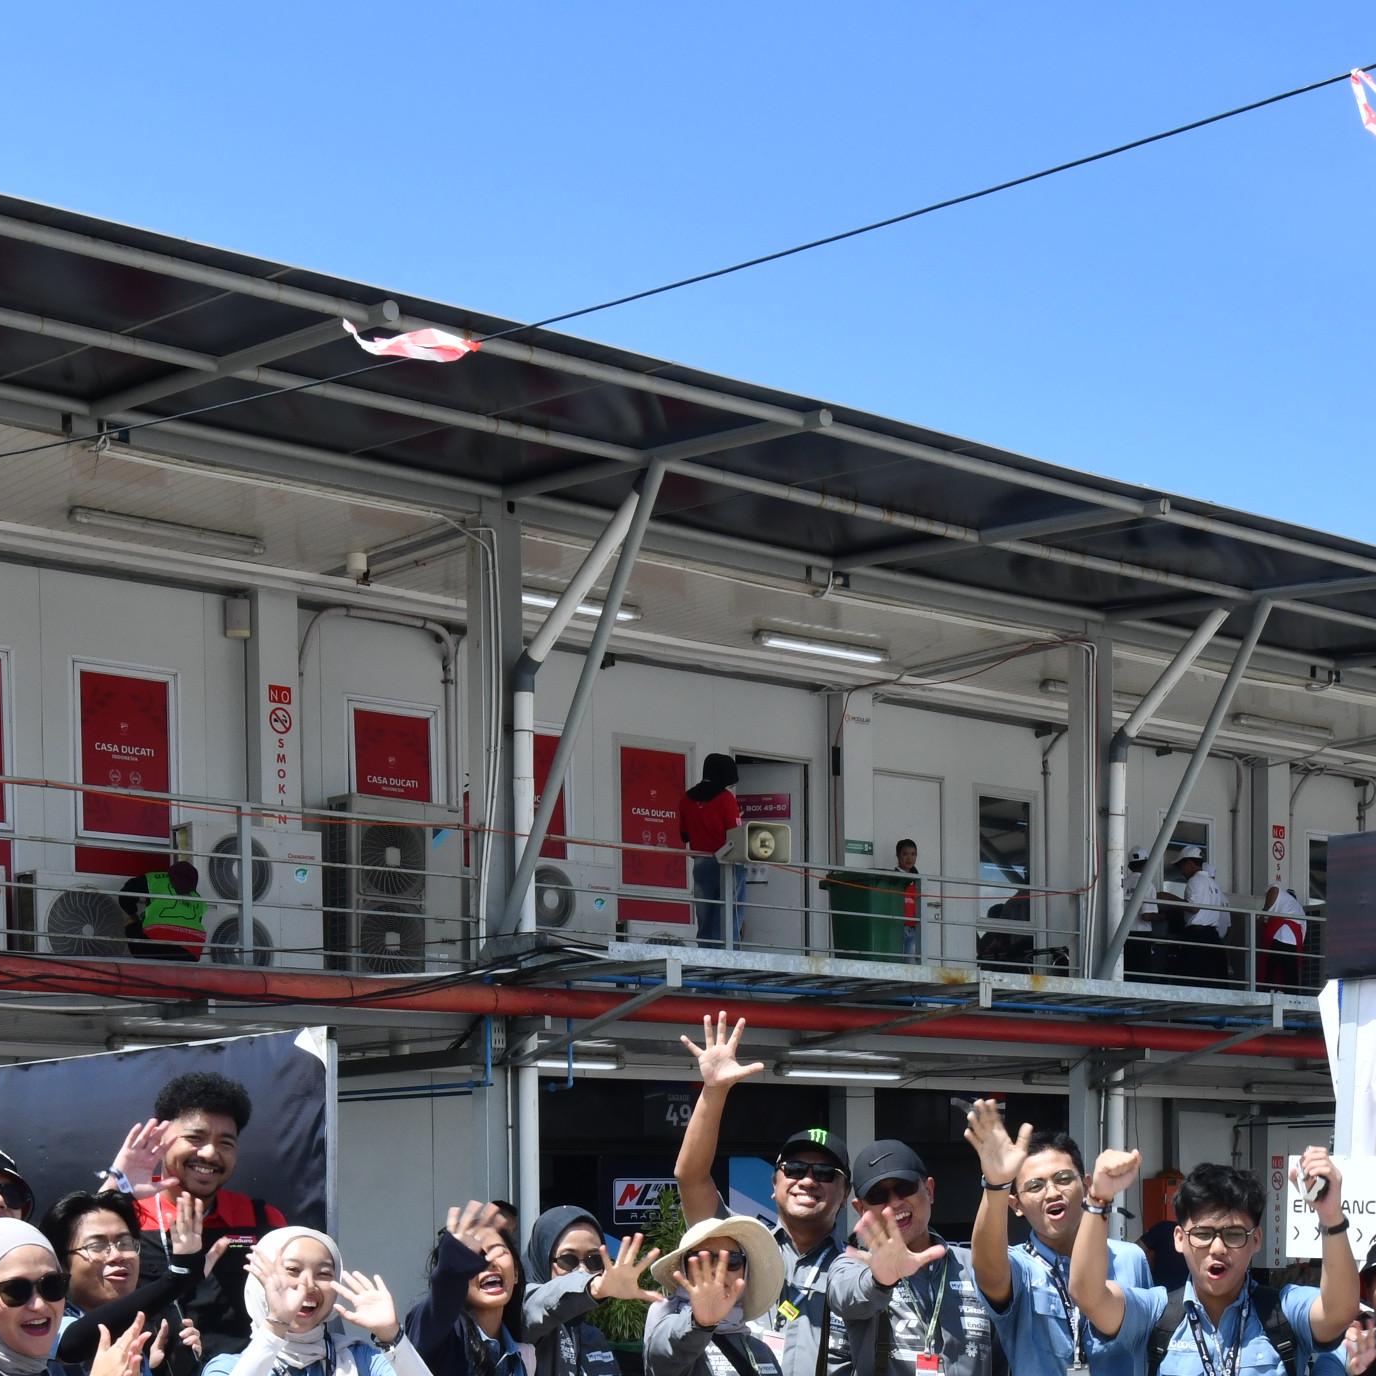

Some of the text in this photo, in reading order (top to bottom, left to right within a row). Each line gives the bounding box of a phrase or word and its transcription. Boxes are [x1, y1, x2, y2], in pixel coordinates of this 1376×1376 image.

[270, 688, 290, 703] NO
[94, 742, 154, 757] CASA DUCATI
[276, 738, 288, 825] SMOKIN
[366, 775, 419, 788] CASA DUCATI
[631, 807, 676, 819] CASA DUCATI
[665, 1103, 692, 1126] 49
[630, 1212, 679, 1220] RACIG
